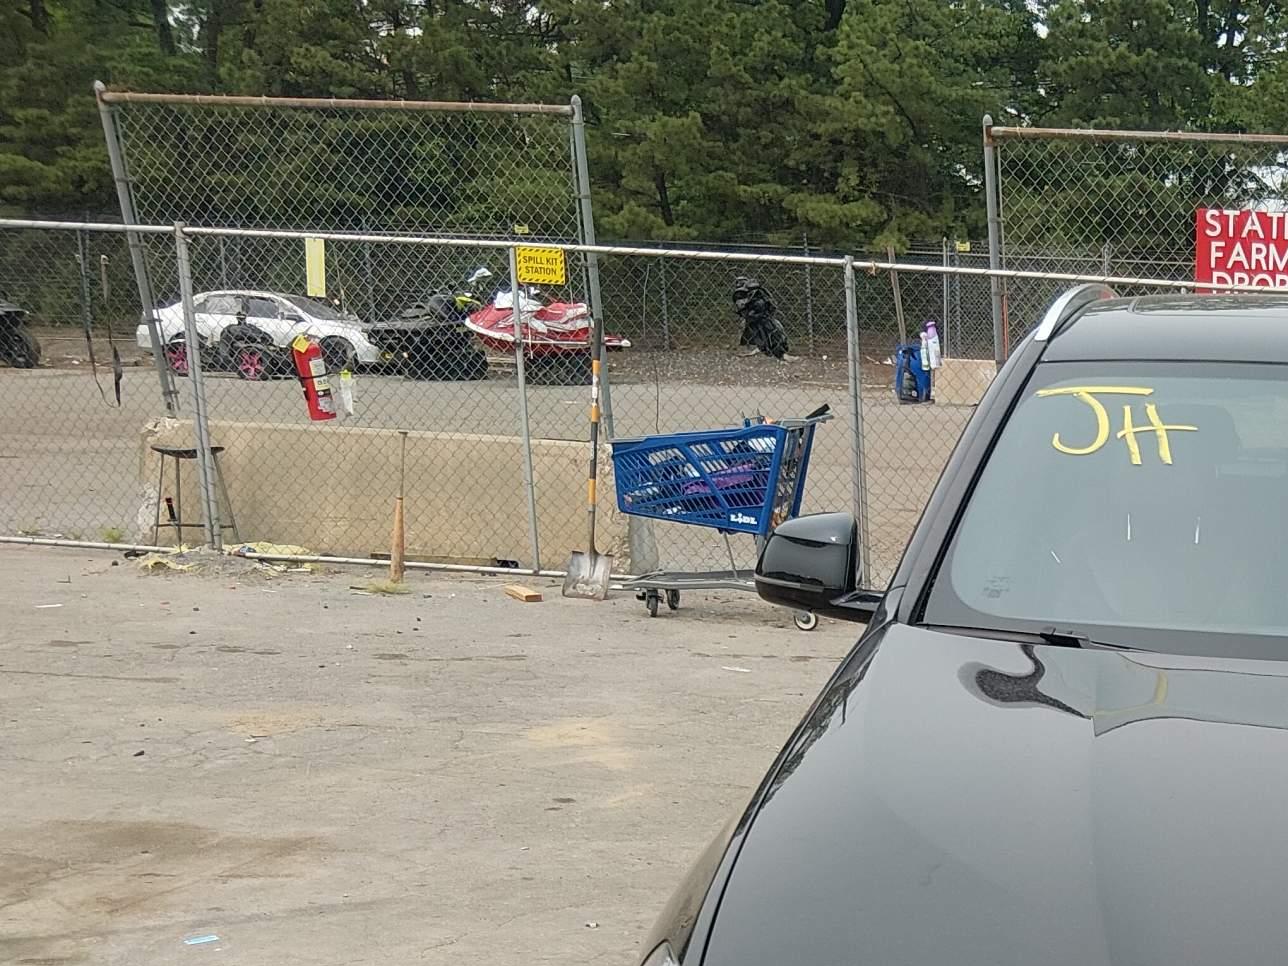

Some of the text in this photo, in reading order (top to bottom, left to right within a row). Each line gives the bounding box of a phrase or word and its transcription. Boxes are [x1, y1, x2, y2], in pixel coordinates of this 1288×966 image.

[522, 255, 558, 266] SPILL KIT
[525, 265, 557, 276] STATION
